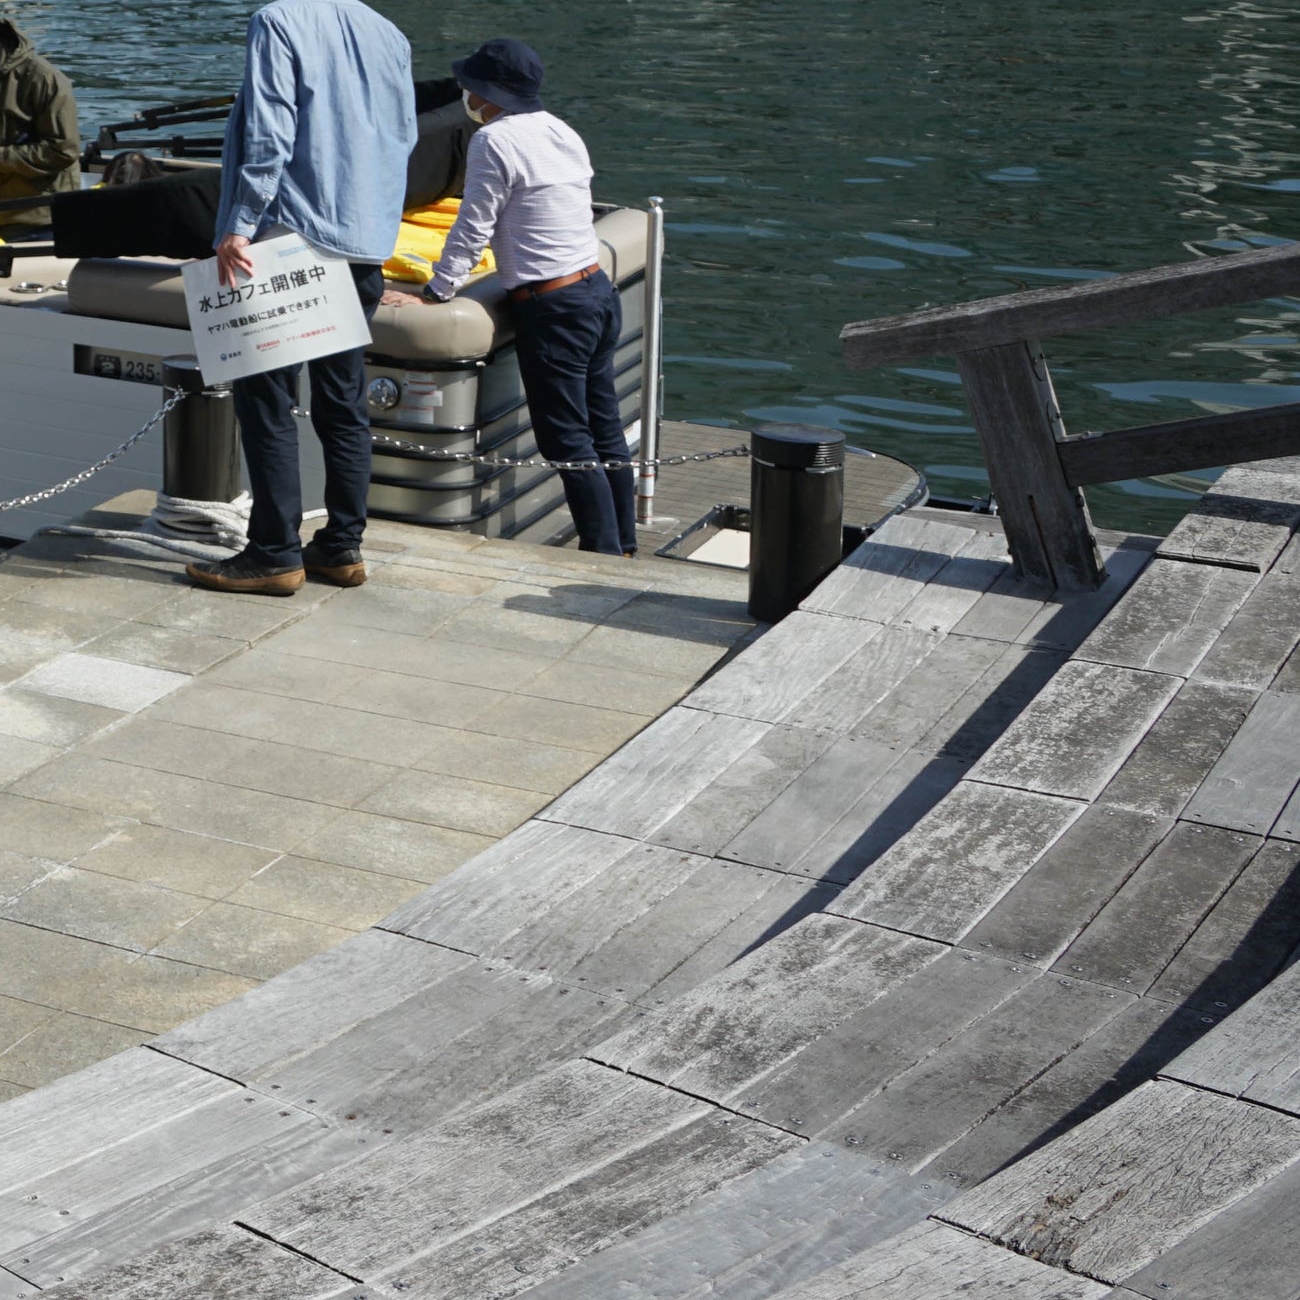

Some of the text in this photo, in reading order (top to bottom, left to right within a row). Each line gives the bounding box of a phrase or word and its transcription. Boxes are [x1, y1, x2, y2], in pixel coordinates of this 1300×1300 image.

[198, 264, 326, 313] 水上カフェ開催中
